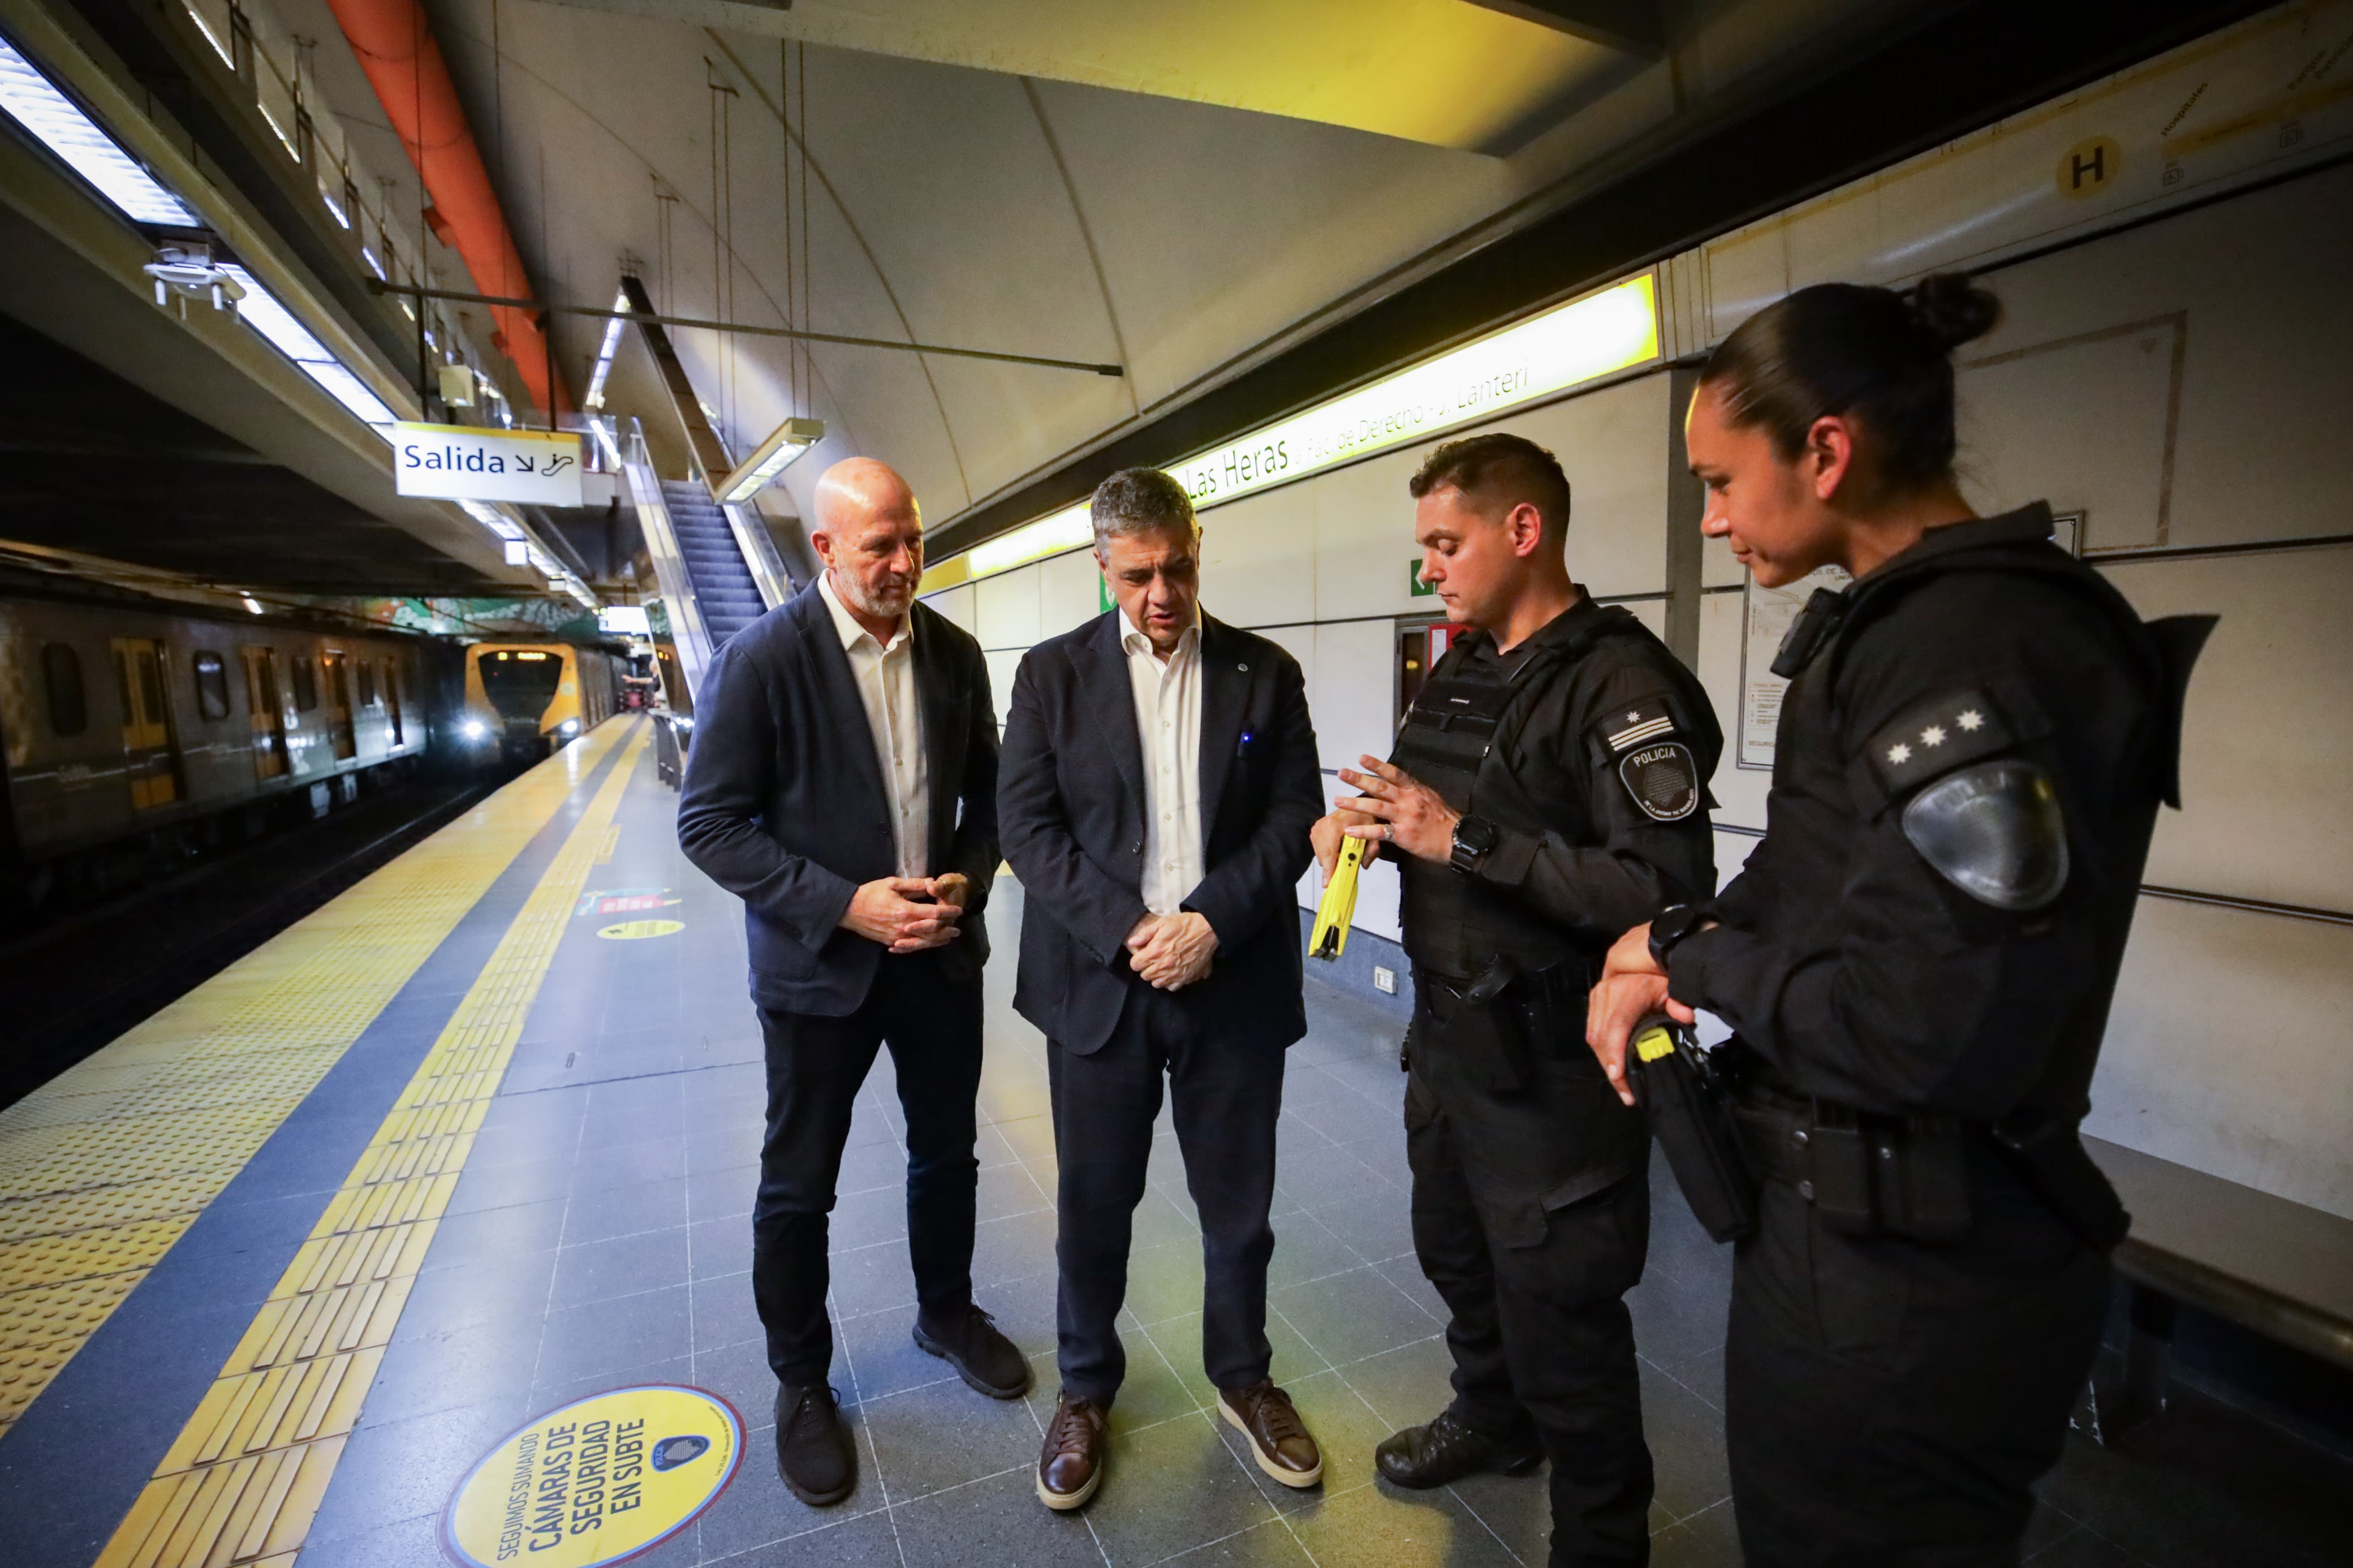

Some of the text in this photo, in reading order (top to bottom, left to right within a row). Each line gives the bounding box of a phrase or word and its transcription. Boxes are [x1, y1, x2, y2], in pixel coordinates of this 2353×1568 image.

[2161, 81, 2208, 137] Hospitales
[2072, 146, 2104, 189] H
[405, 445, 505, 473] Salida
[1186, 468, 1217, 499] Las
[1223, 440, 1288, 488] Heras
[1359, 404, 1423, 442] Derecho
[1458, 359, 1527, 409] Lanteri
[1634, 747, 1676, 767] POLICIA
[497, 1433, 539, 1561] SEGUIMOS SUMANDO
[525, 1423, 576, 1552] CÁMARAS DE
[570, 1420, 610, 1535] SEGURIDAD
[610, 1419, 644, 1514] EN SUBTE
